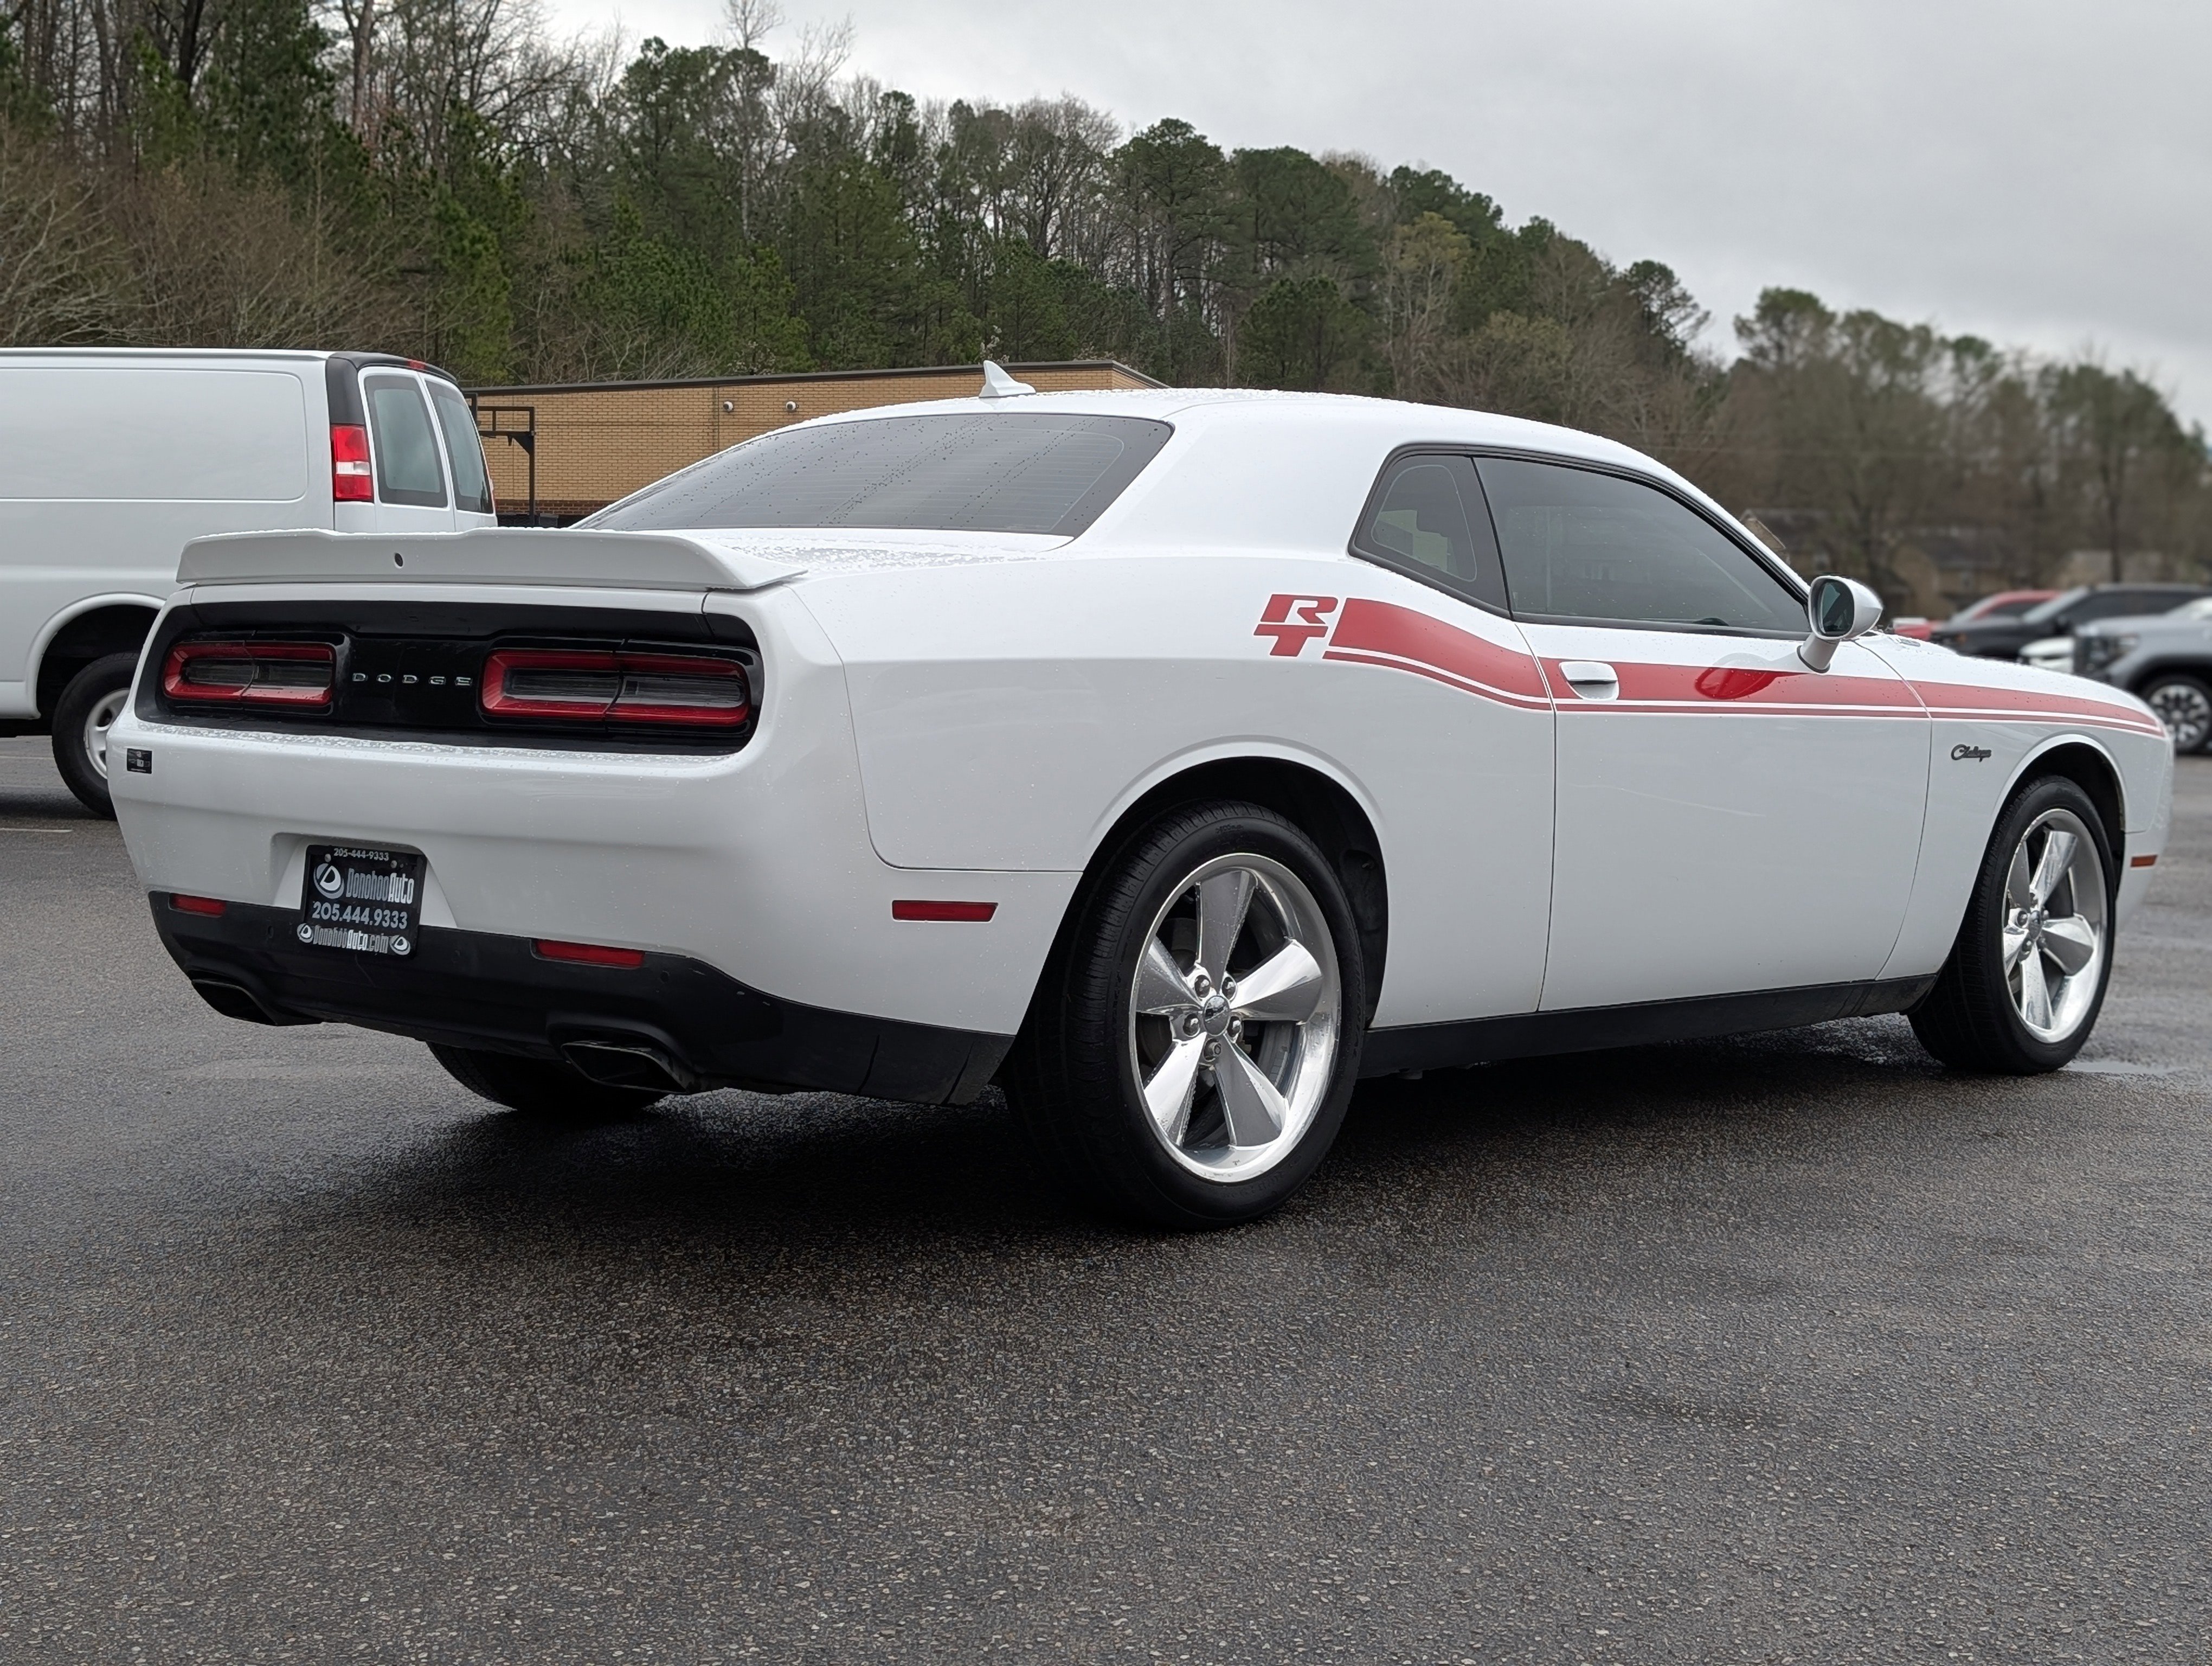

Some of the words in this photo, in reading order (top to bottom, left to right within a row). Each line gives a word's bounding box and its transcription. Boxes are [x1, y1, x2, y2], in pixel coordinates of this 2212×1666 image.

[352, 673, 471, 685] DODGE
[333, 848, 389, 861] 205-444-9333
[345, 868, 415, 904] DonohooAuto
[312, 901, 408, 930] 205.444.9333
